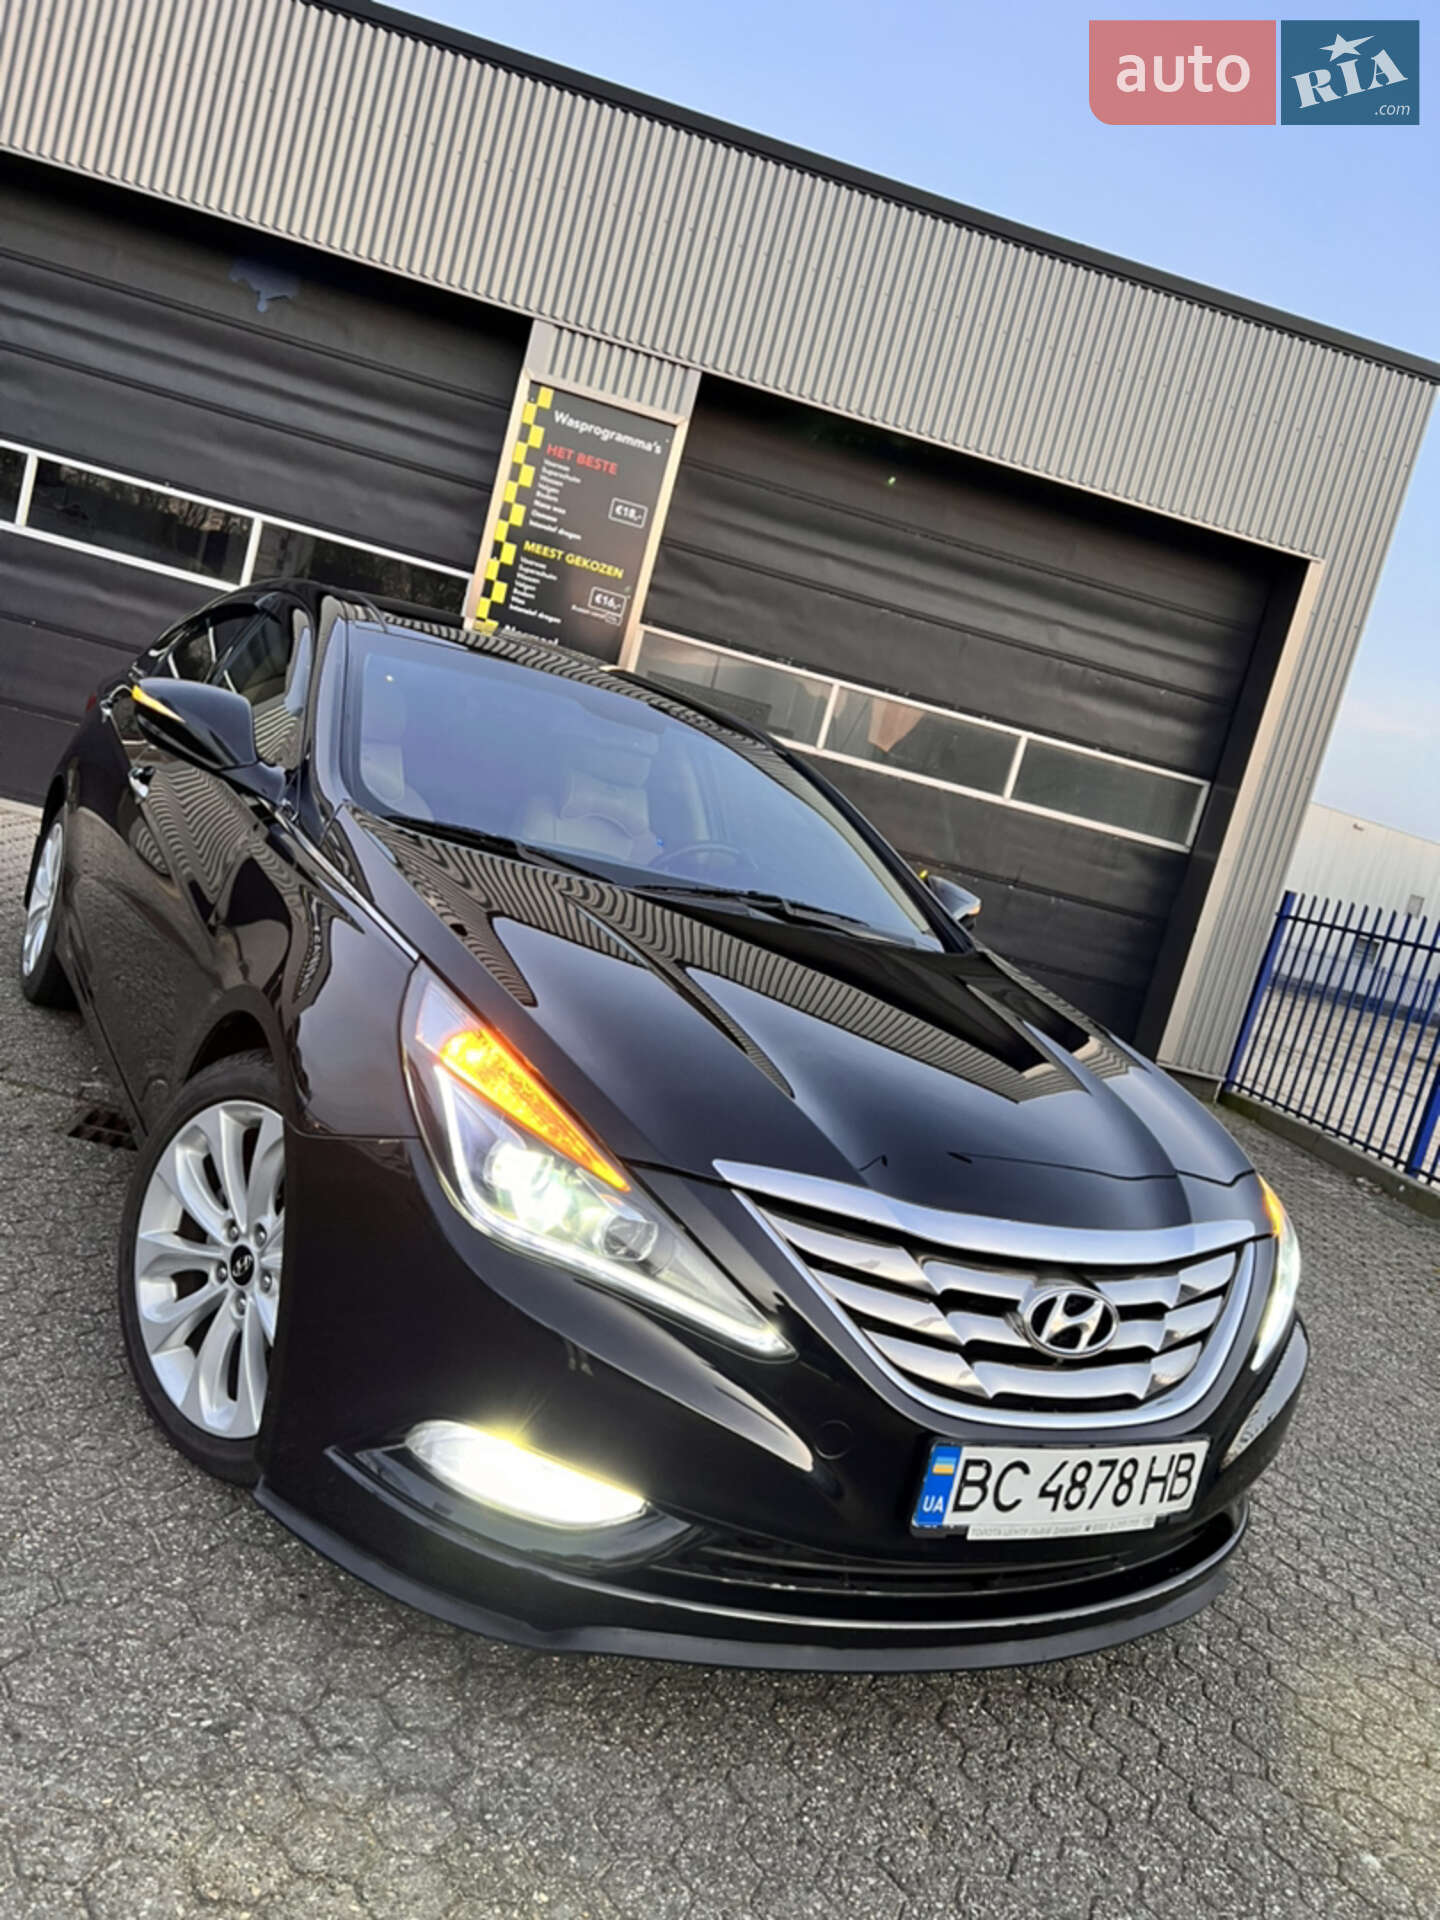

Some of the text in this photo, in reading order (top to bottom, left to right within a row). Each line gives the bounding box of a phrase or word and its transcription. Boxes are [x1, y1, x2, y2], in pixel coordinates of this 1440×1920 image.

[554, 409, 662, 454] Wasprogramma's
[546, 443, 618, 475] HET BESTE
[523, 540, 624, 579] MEEST GEKOZEN
[952, 1452, 1196, 1513] BC 4878 HB
[922, 1495, 944, 1512] UA
